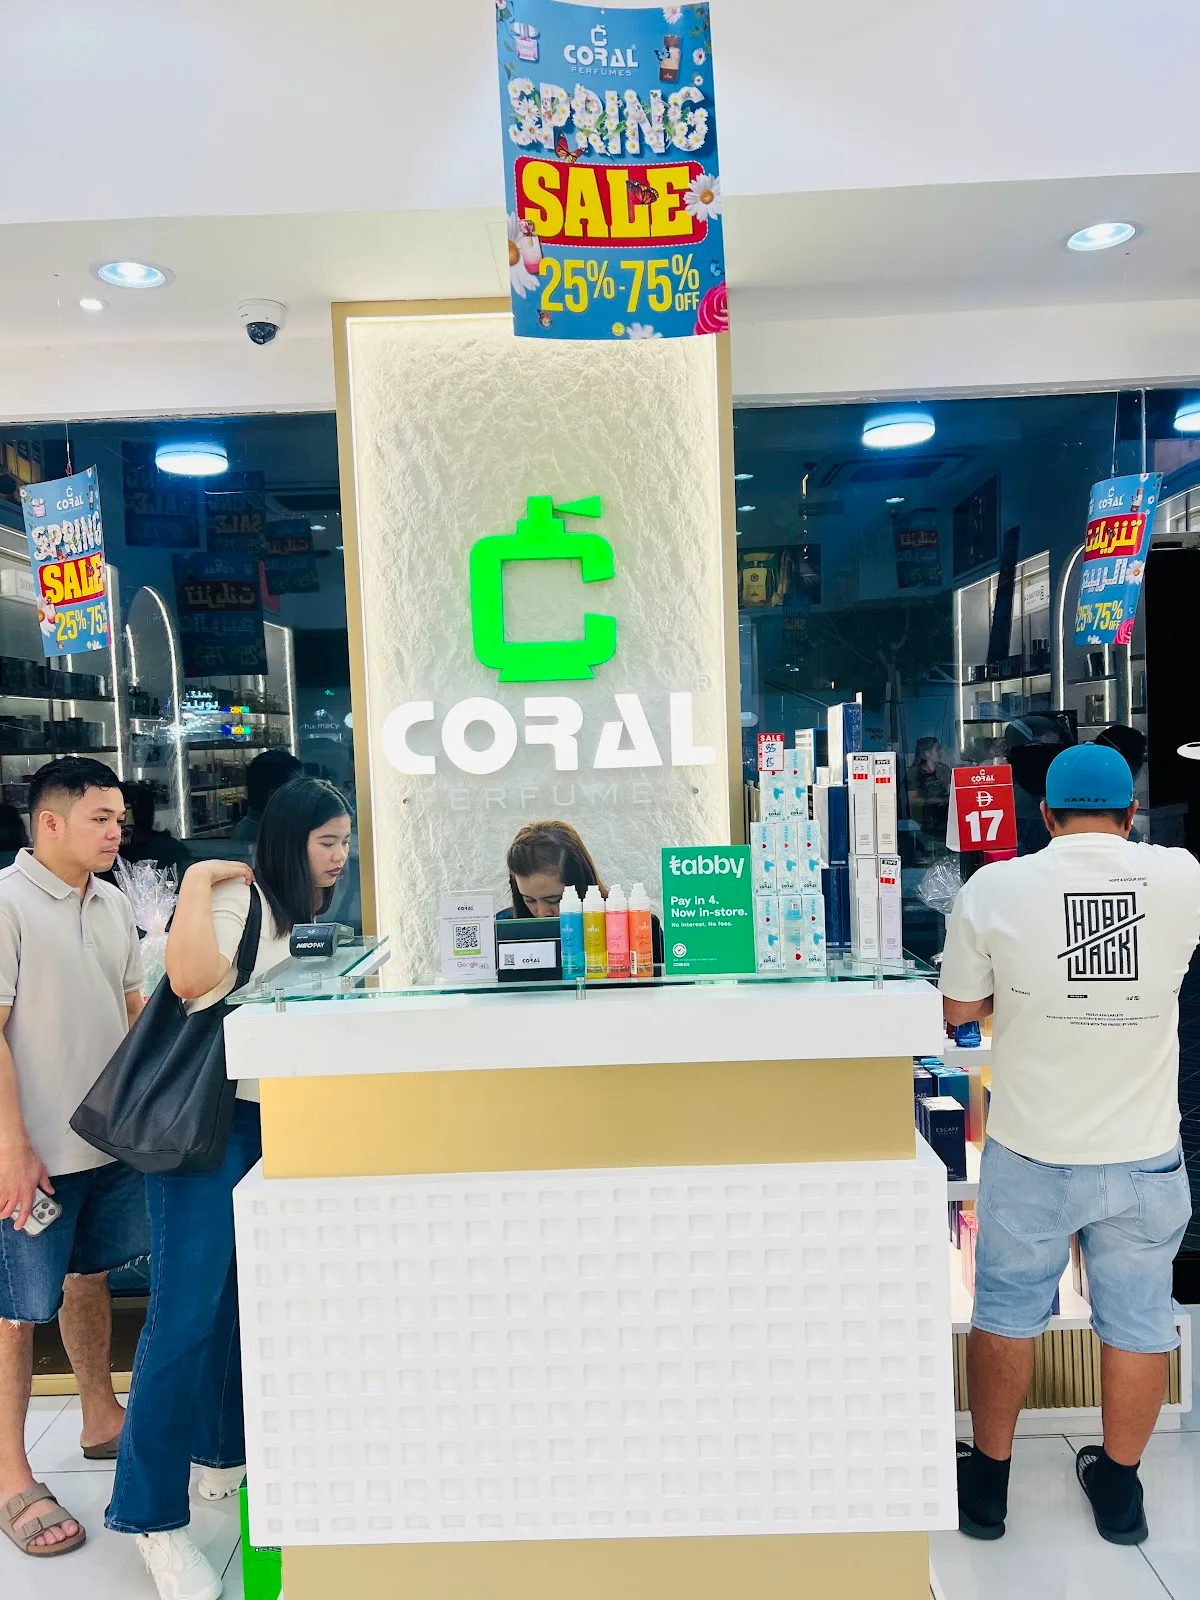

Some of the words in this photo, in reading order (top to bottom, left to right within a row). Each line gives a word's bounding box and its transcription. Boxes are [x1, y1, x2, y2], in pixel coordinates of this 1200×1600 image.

[564, 45, 638, 67] CORAL
[571, 67, 632, 76] PERFUMES
[508, 77, 708, 155] SPRING
[522, 160, 694, 238] SALE
[674, 292, 699, 312] OFF
[56, 494, 84, 510] CORAL
[1098, 494, 1124, 510] CORAL
[31, 510, 102, 561] SPRING
[43, 552, 104, 604] SALE
[383, 691, 717, 775] CORAL
[966, 810, 1004, 842] 17
[669, 855, 744, 878] tabby
[671, 896, 691, 908] Pay
[695, 896, 704, 904] in
[708, 896, 719, 904] 4.
[672, 908, 695, 917] Now
[700, 908, 748, 917] in-store.
[1072, 899, 1129, 944] HOBO
[1075, 929, 1132, 974] JACK
[457, 961, 478, 969] Google
